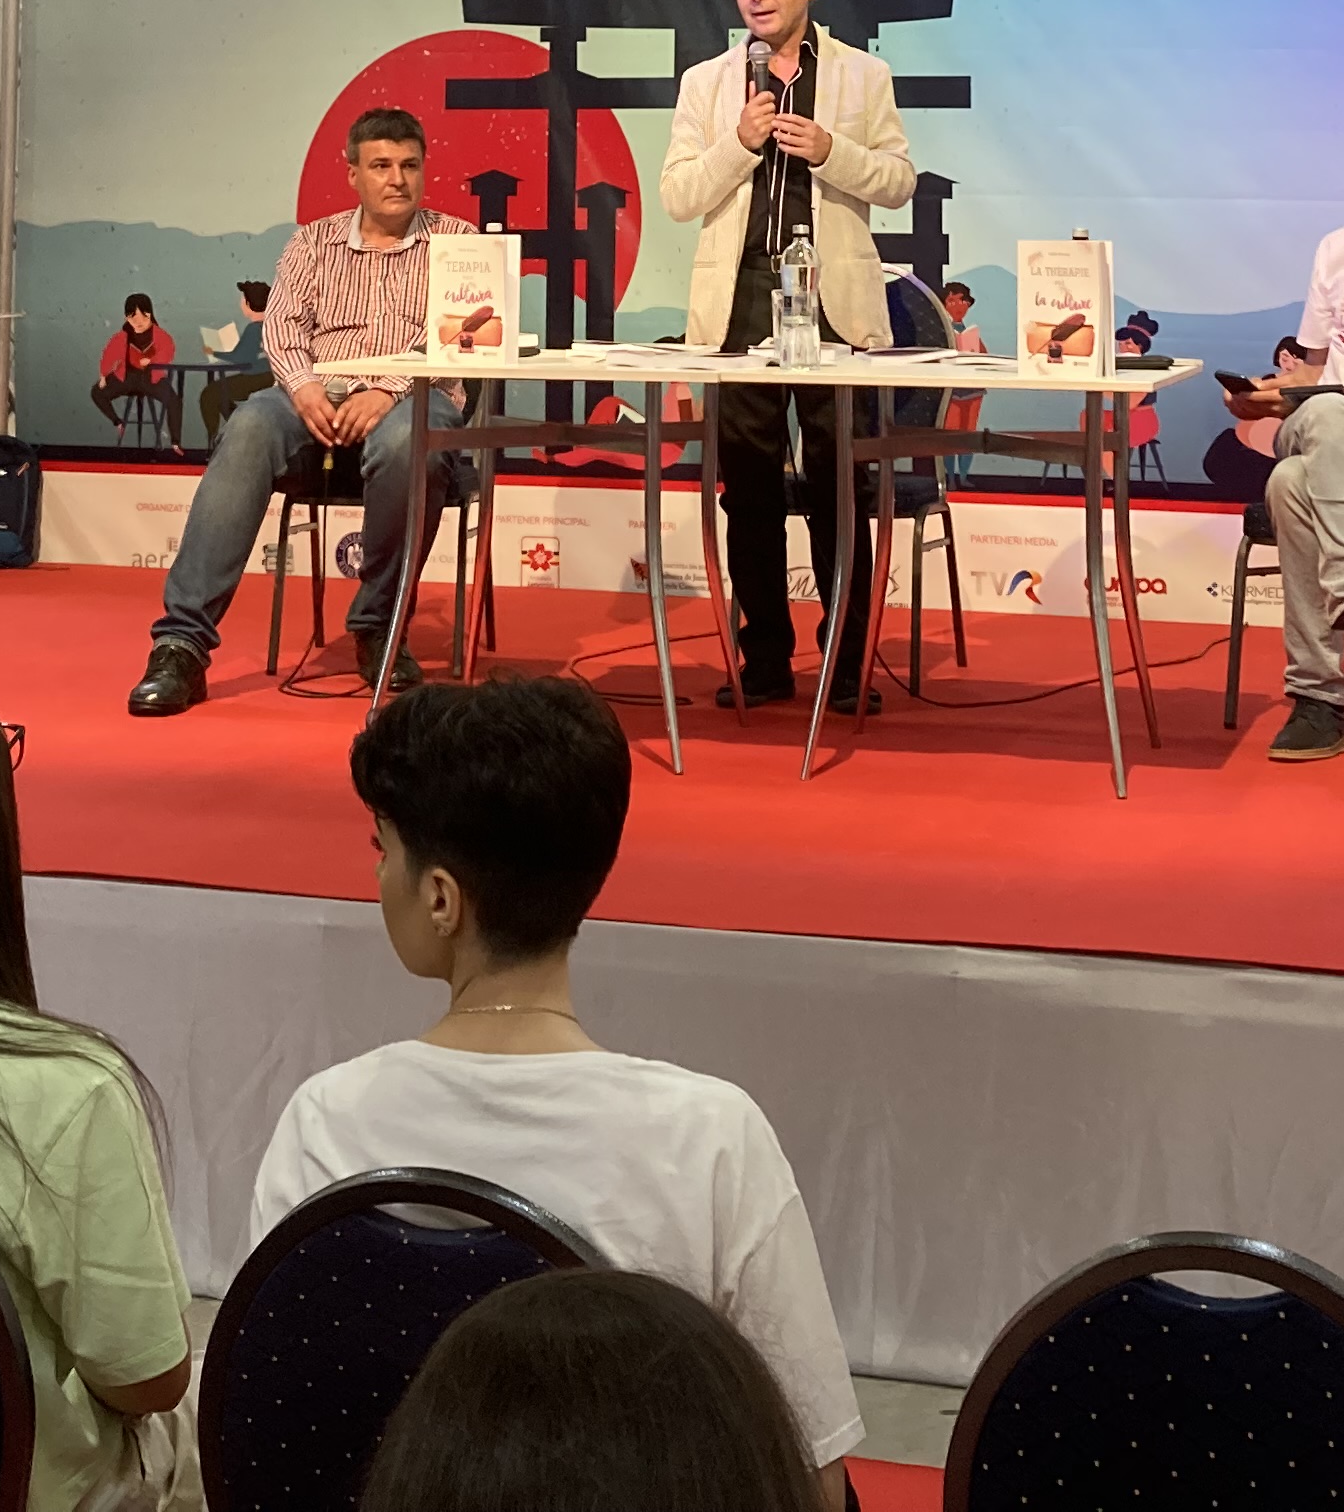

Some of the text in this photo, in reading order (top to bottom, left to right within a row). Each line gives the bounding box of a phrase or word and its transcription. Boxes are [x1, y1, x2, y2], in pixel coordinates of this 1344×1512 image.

[445, 261, 492, 273] TERAPIA
[1031, 266, 1042, 276] LA
[136, 503, 183, 513] ORGANIZAT
[495, 514, 540, 525] PARTENER
[970, 534, 1023, 546] PARTENERI
